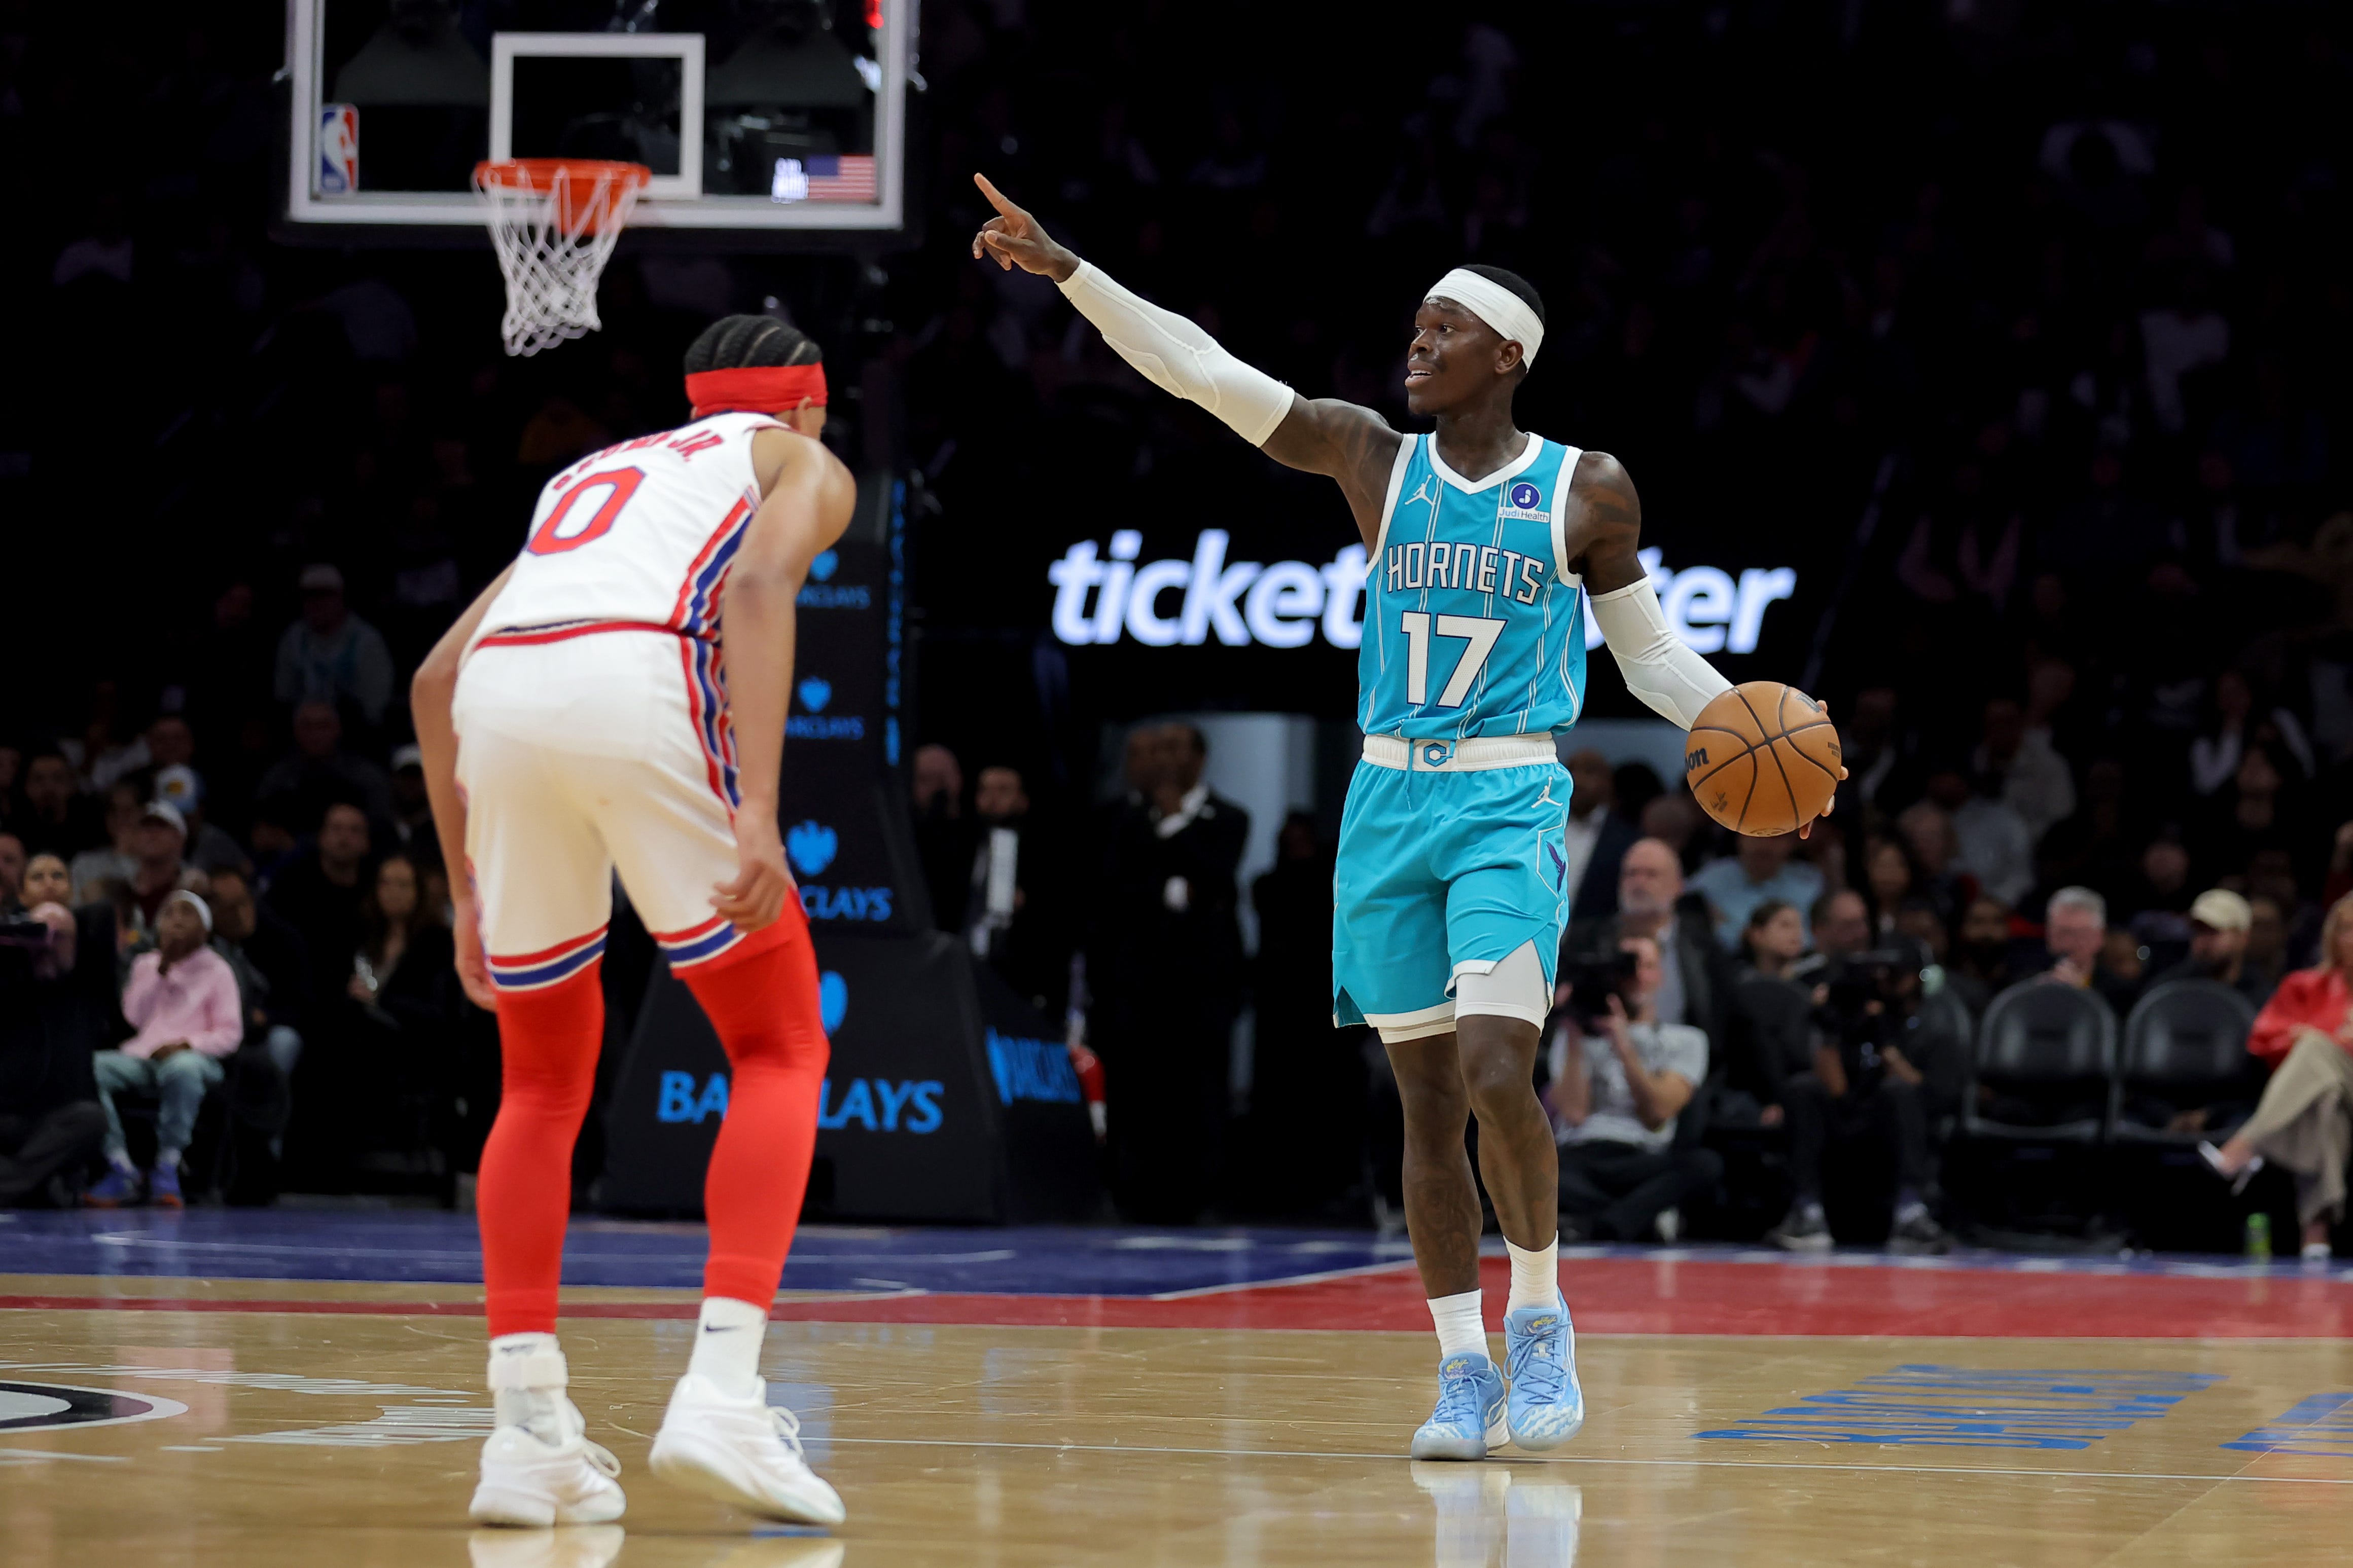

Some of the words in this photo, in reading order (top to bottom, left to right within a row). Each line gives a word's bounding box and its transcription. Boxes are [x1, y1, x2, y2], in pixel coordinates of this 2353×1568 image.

[528, 465, 647, 557] 0
[1499, 509, 1520, 518] Judi
[1521, 511, 1549, 522] Health
[1386, 541, 1545, 606] HORNETS
[1401, 610, 1509, 708] 17
[656, 1069, 945, 1135] BALAYS
